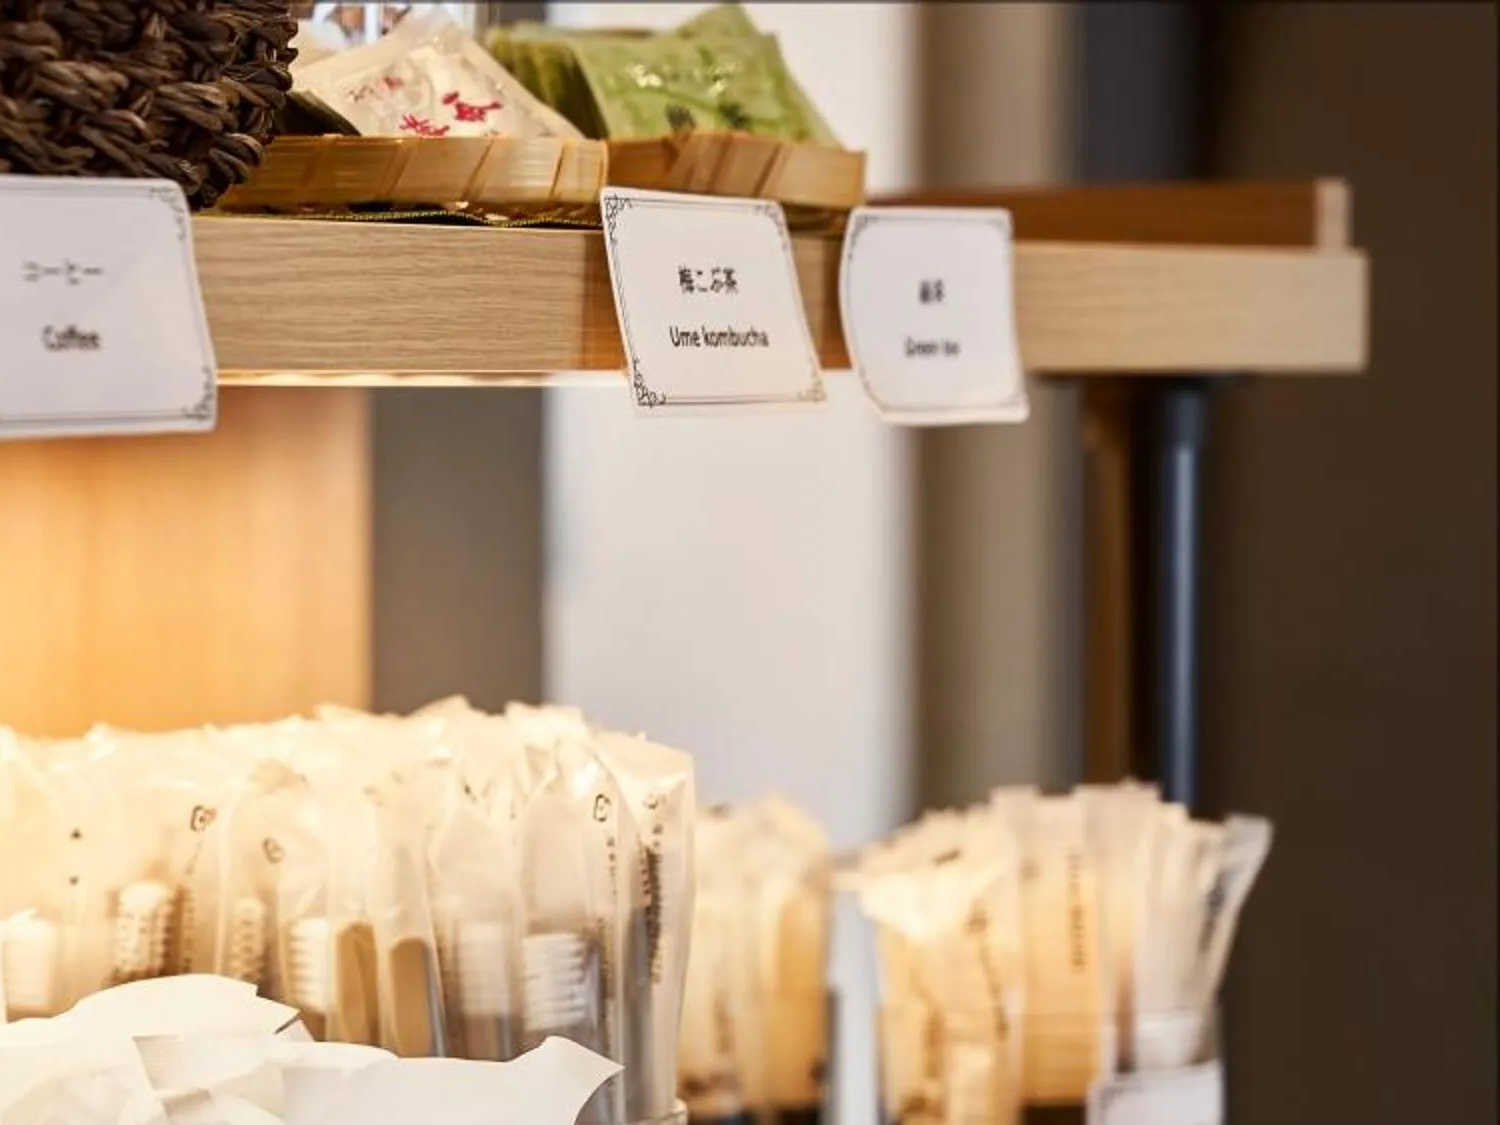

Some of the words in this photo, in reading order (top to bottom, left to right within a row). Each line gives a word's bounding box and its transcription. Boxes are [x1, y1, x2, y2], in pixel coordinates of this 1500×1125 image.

[41, 324, 101, 351] Coffee
[668, 326, 700, 347] Ume
[701, 325, 769, 347] kombucha
